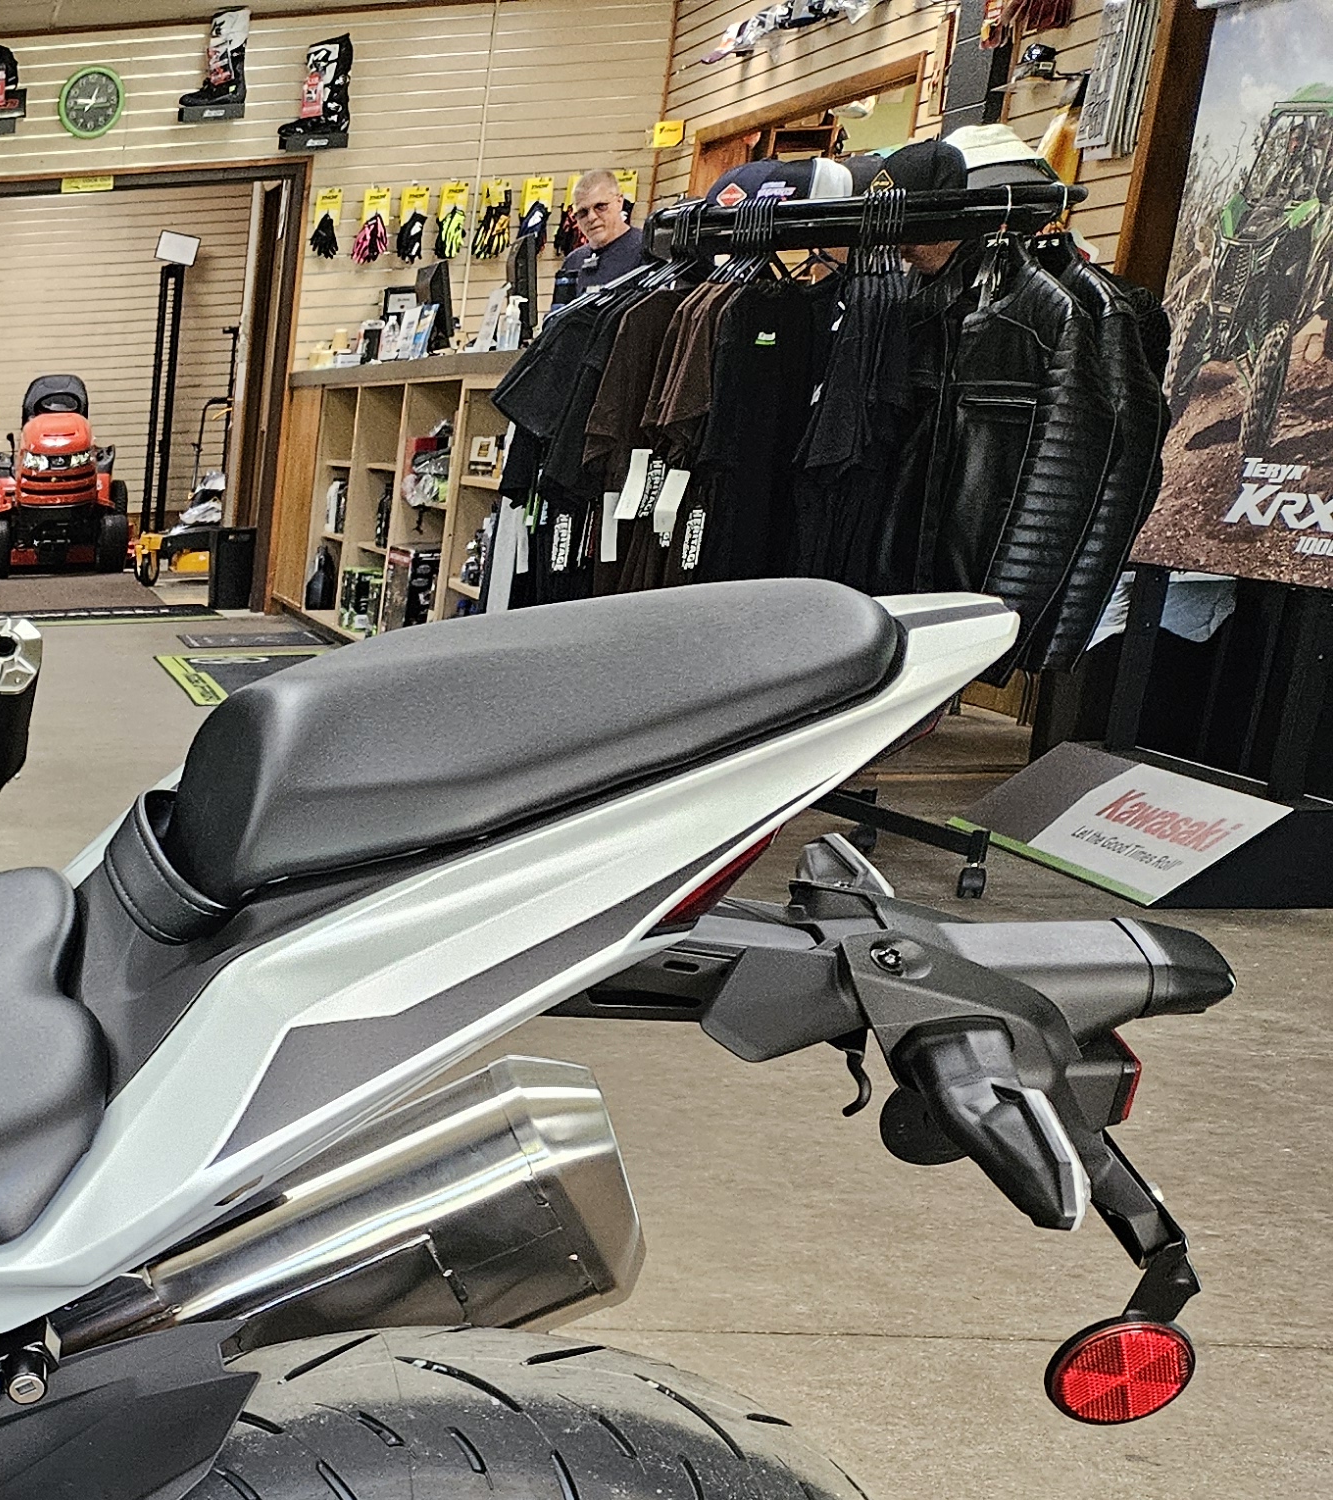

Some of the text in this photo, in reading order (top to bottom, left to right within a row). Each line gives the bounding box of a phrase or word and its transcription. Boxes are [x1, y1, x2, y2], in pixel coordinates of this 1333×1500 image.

[1095, 789, 1244, 852] Kawasaki
[1100, 836, 1130, 854] Good
[1124, 844, 1156, 865] Times
